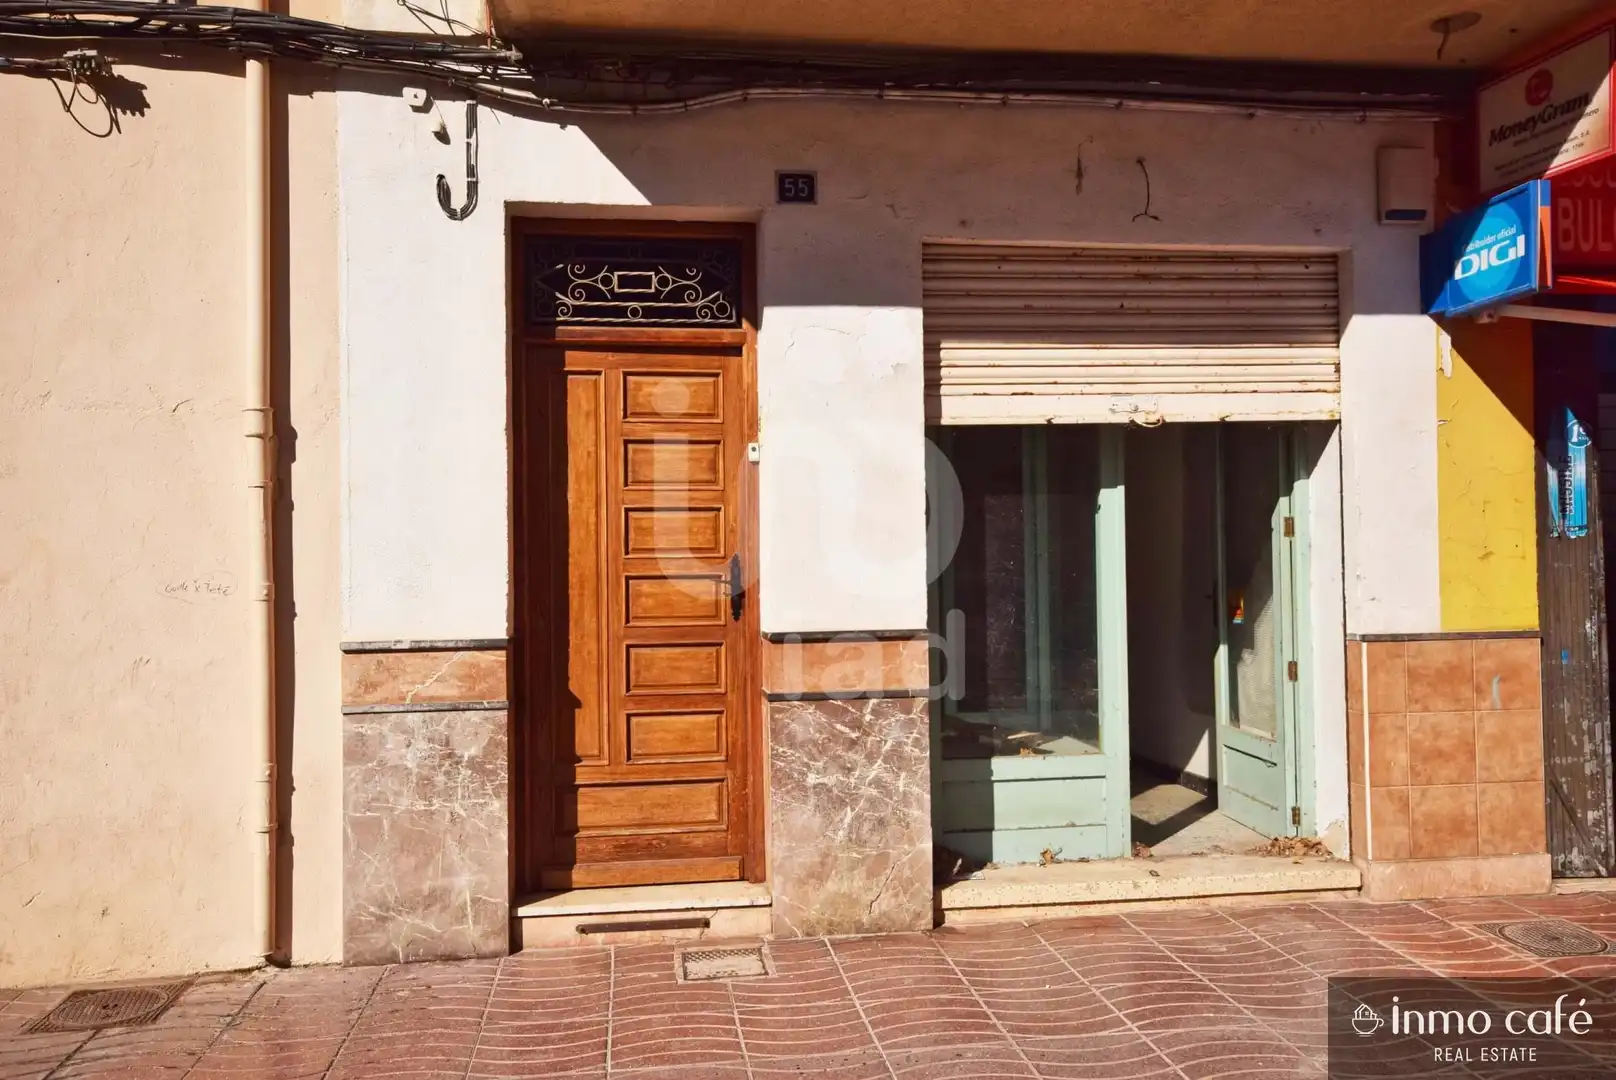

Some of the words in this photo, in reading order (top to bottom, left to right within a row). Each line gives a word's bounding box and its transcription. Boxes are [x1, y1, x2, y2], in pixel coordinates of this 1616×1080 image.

[1489, 93, 1590, 146] MoneyGram
[784, 178, 809, 197] 55
[1557, 197, 1616, 253] BUL
[1454, 234, 1526, 281] DIGI
